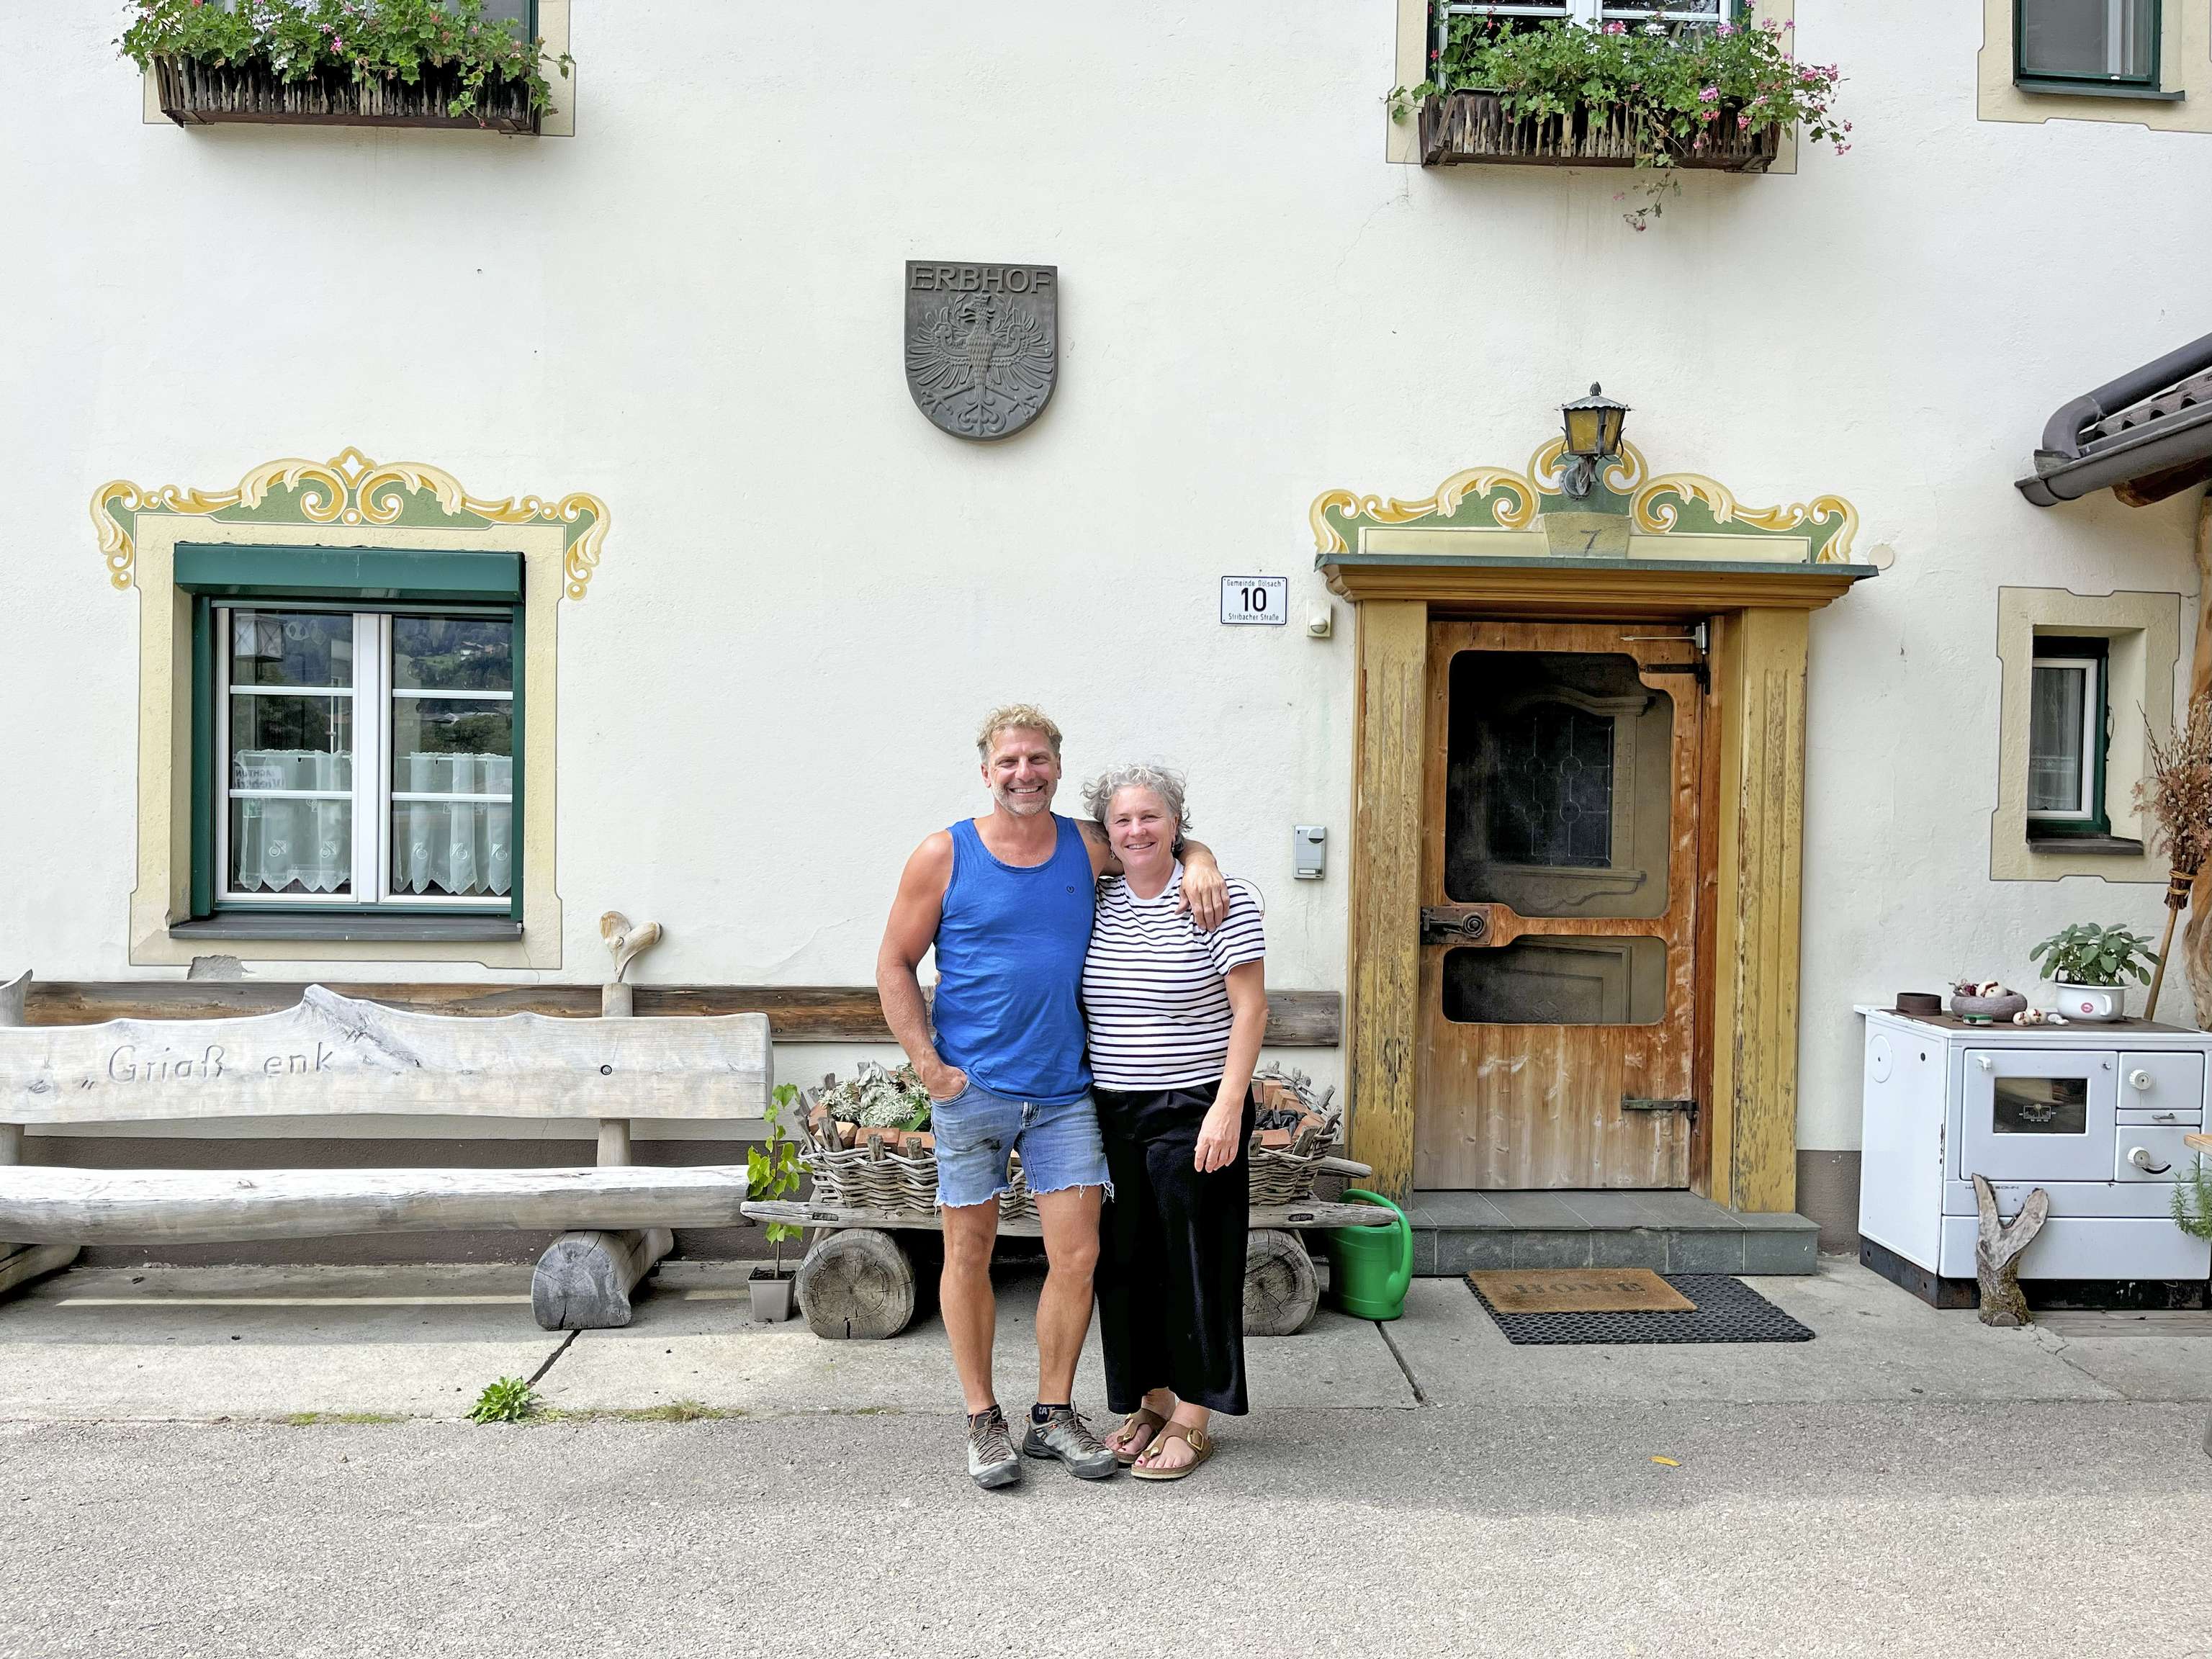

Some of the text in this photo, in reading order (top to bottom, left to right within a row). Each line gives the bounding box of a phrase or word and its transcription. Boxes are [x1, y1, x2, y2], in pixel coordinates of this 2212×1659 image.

[909, 265, 1053, 294] ERBHOF
[1580, 529, 1602, 554] 7
[1241, 587, 1267, 612] 10
